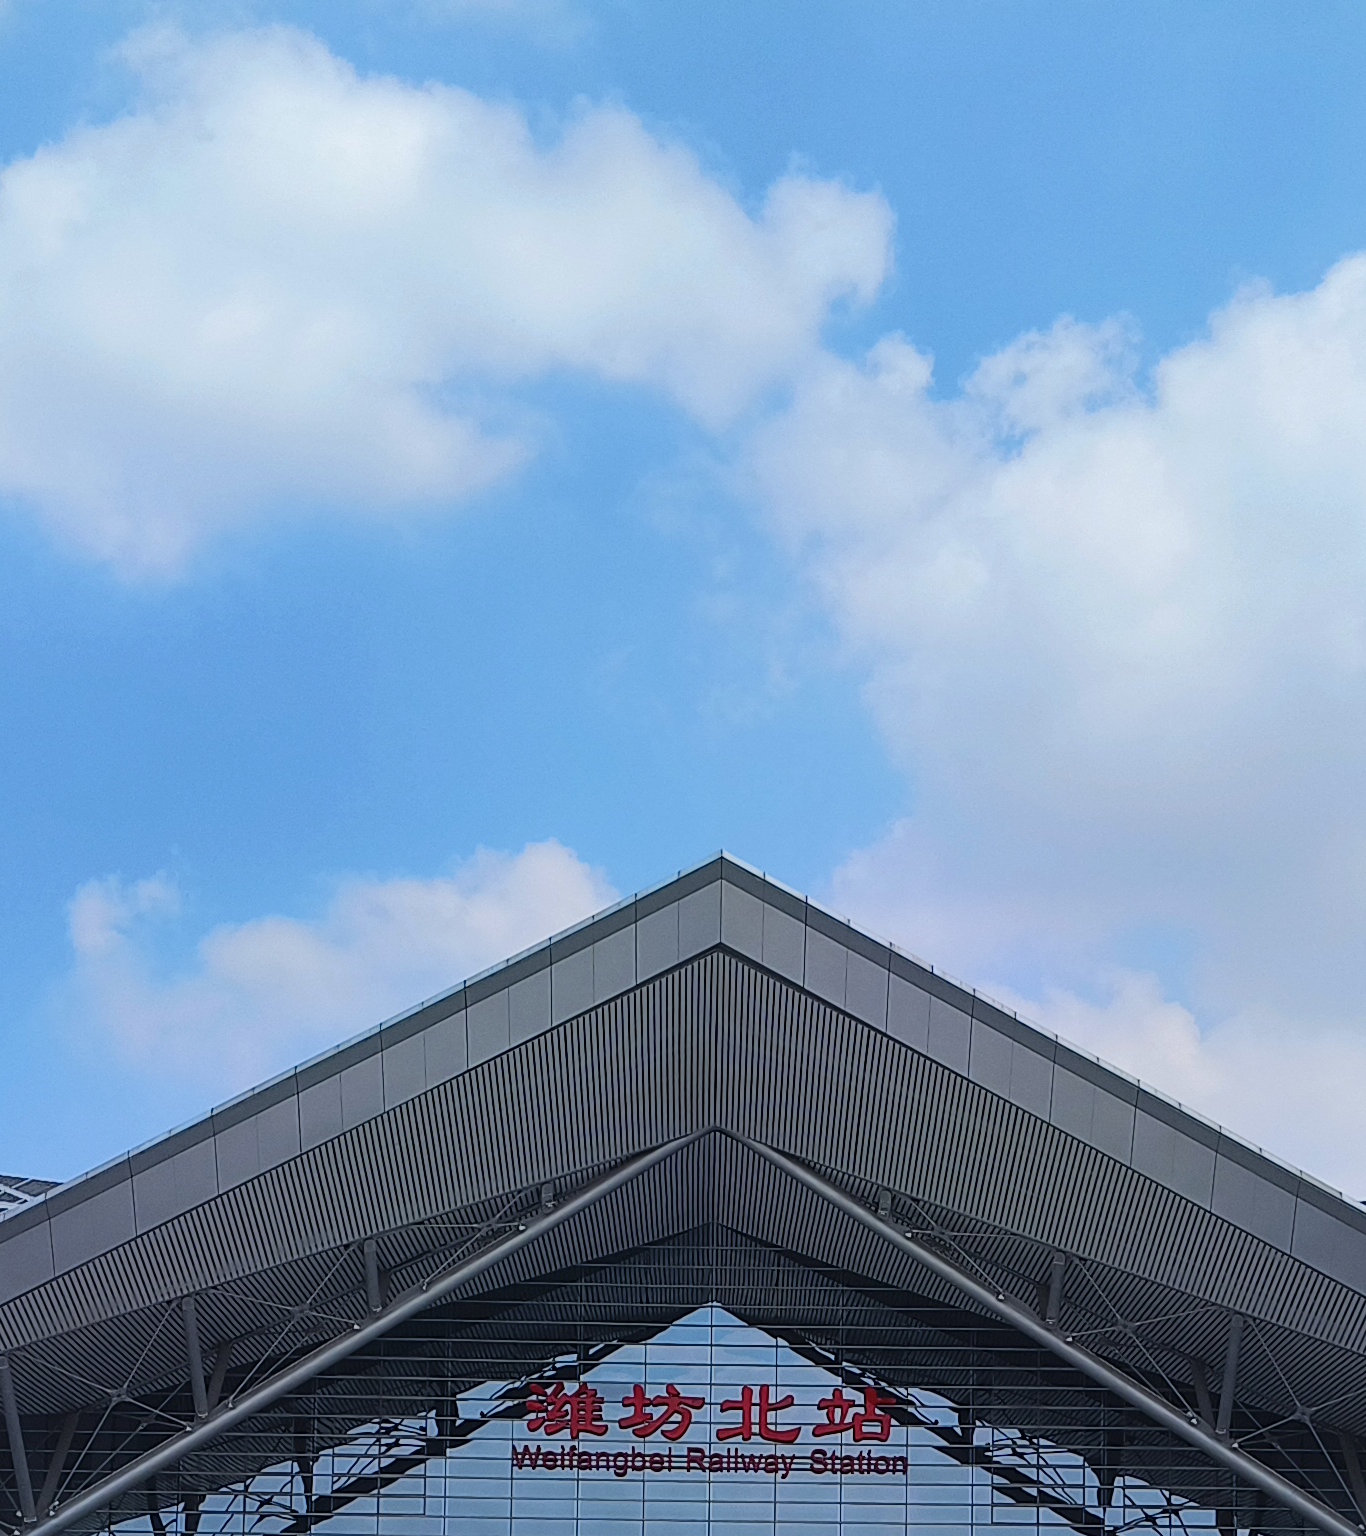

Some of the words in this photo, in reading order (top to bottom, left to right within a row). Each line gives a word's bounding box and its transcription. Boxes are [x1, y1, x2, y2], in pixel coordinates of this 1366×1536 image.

[526, 1381, 897, 1443] 潍坊北站
[511, 1445, 673, 1477] Weifangbei
[685, 1447, 796, 1479] Railway
[809, 1449, 909, 1476] Station
